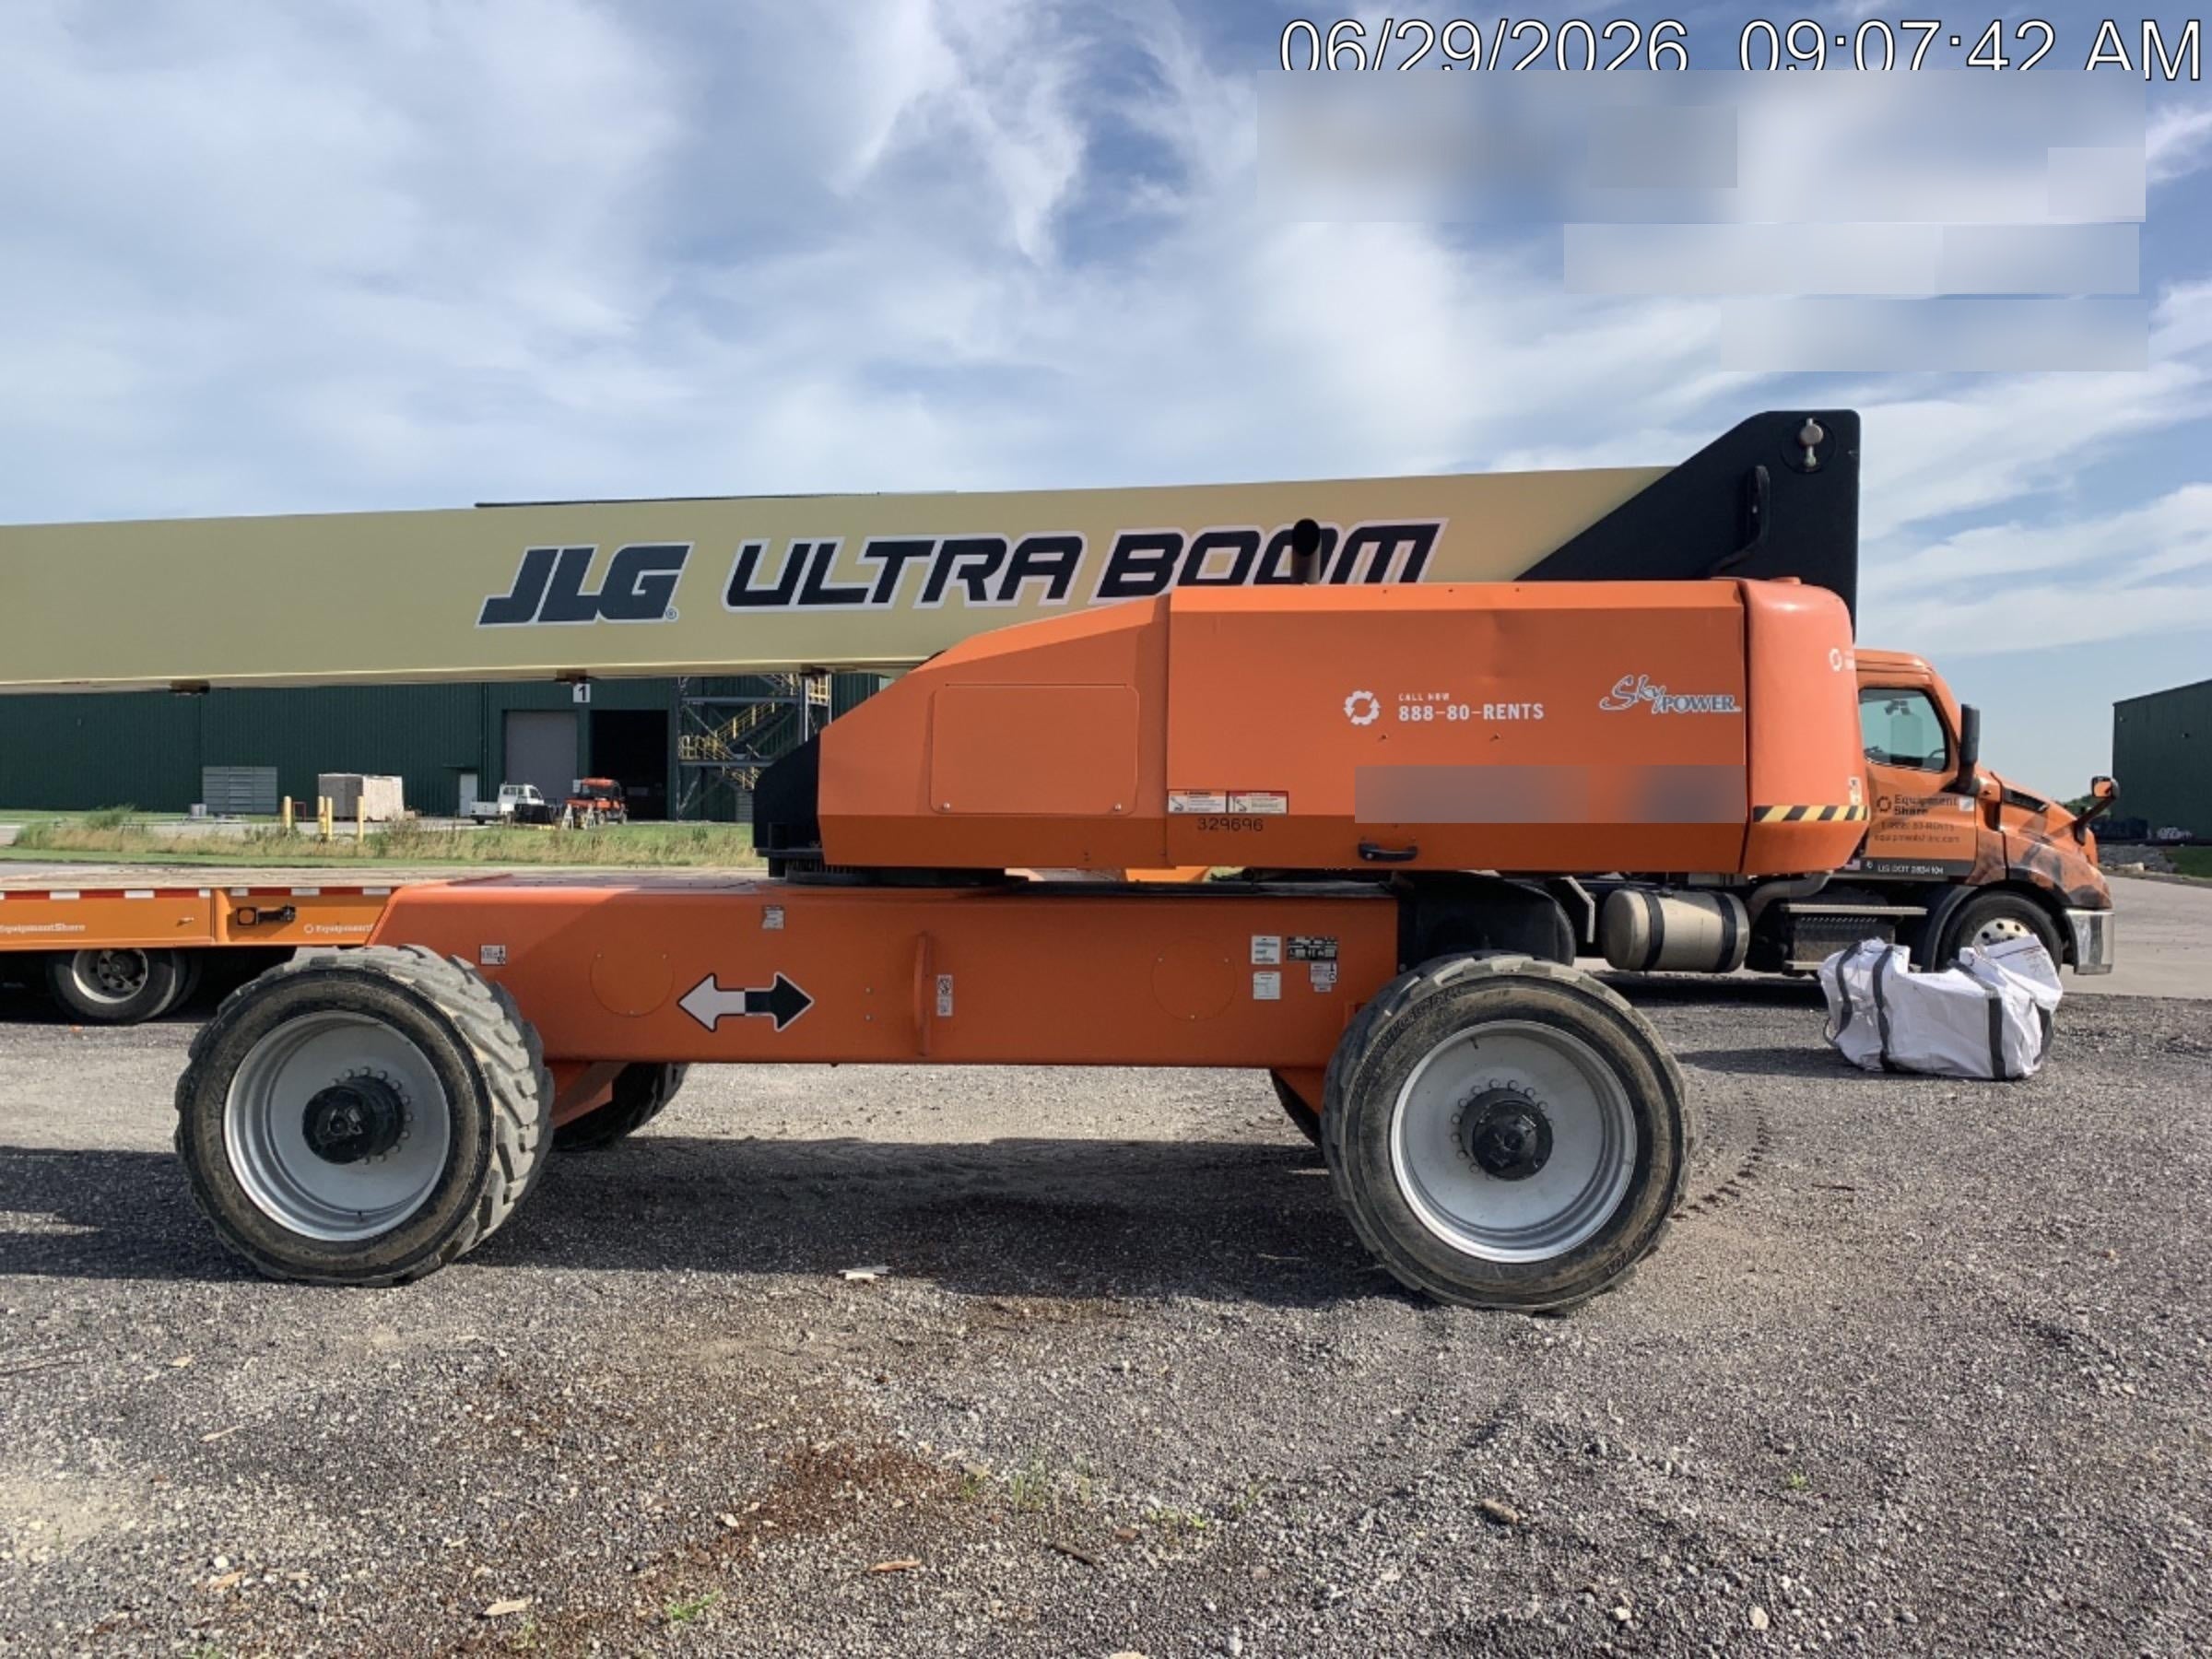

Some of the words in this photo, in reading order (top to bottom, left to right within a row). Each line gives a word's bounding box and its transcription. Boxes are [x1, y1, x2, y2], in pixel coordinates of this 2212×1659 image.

[723, 532, 1088, 612] ULTRA
[1089, 518, 1448, 605] BOOM
[1398, 693, 1423, 701] CALL
[1599, 675, 1666, 714] Sky
[1659, 694, 1742, 713] POWER
[1398, 703, 1545, 722] 888-80-RENTS
[1197, 818, 1264, 831] 329696
